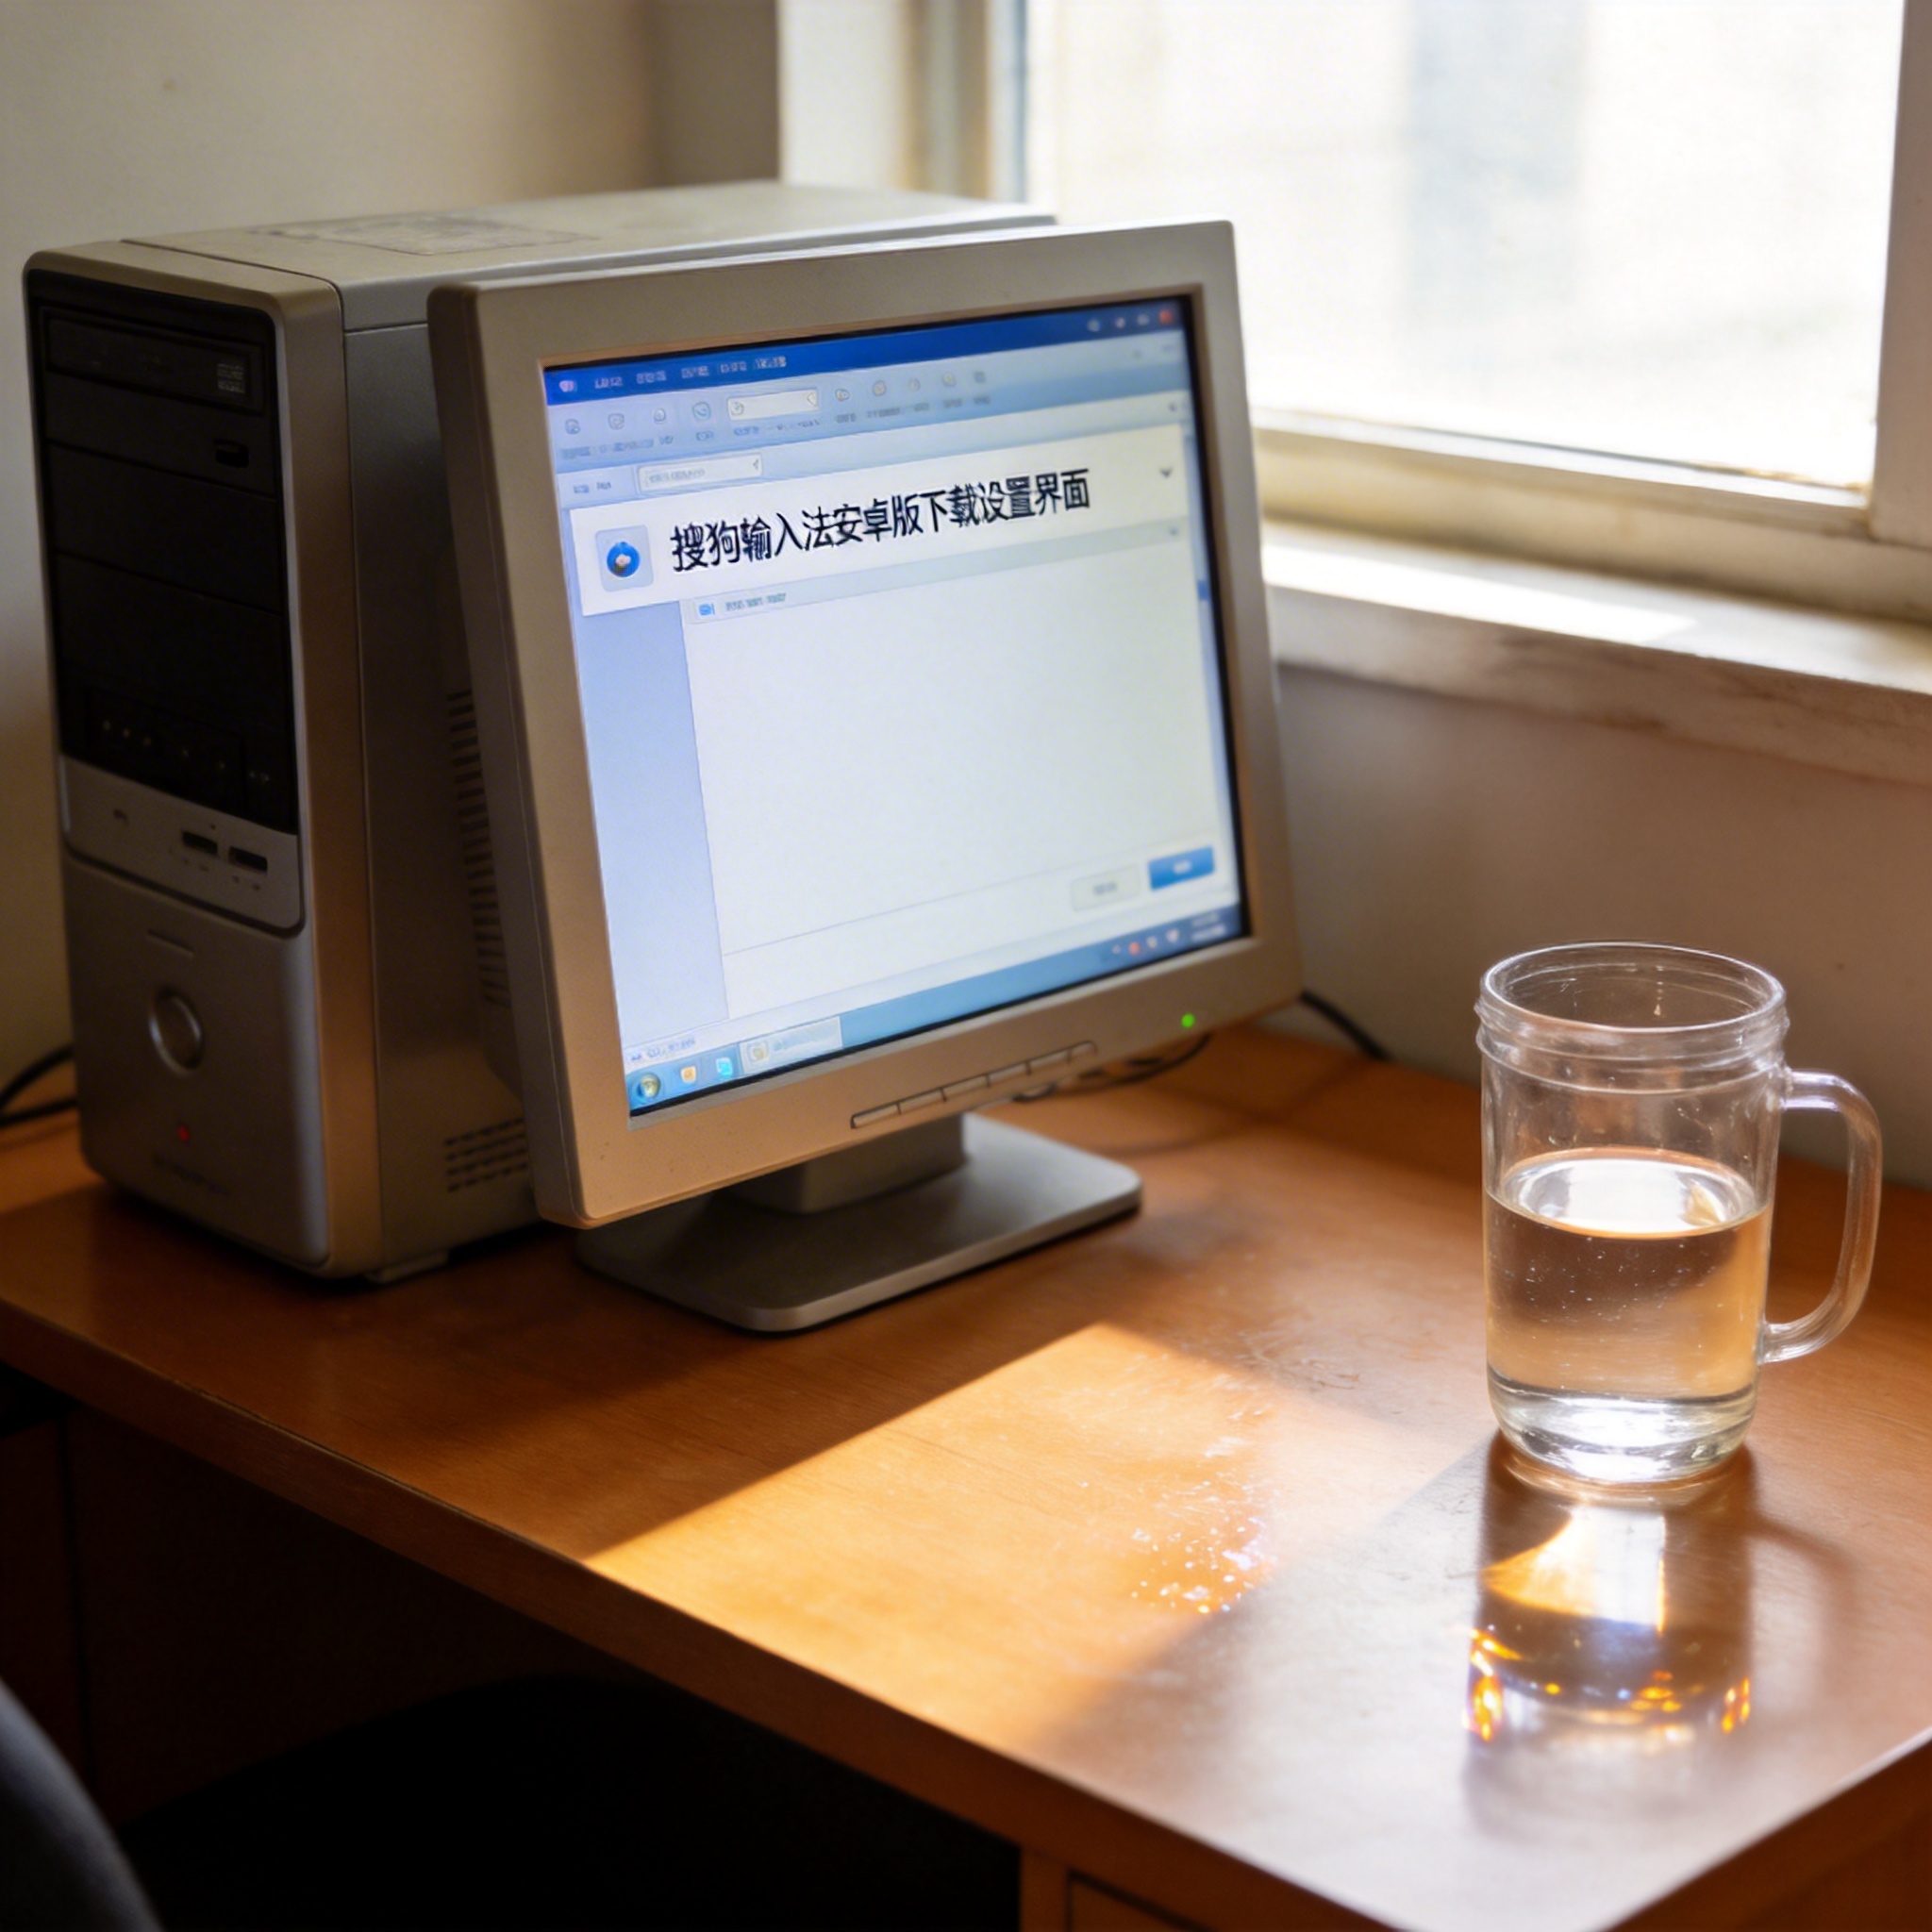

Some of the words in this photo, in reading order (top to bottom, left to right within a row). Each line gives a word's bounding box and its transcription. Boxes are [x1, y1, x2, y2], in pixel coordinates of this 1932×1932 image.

[670, 469, 1090, 572] 搜狗输入法安卓版下载设置界面
